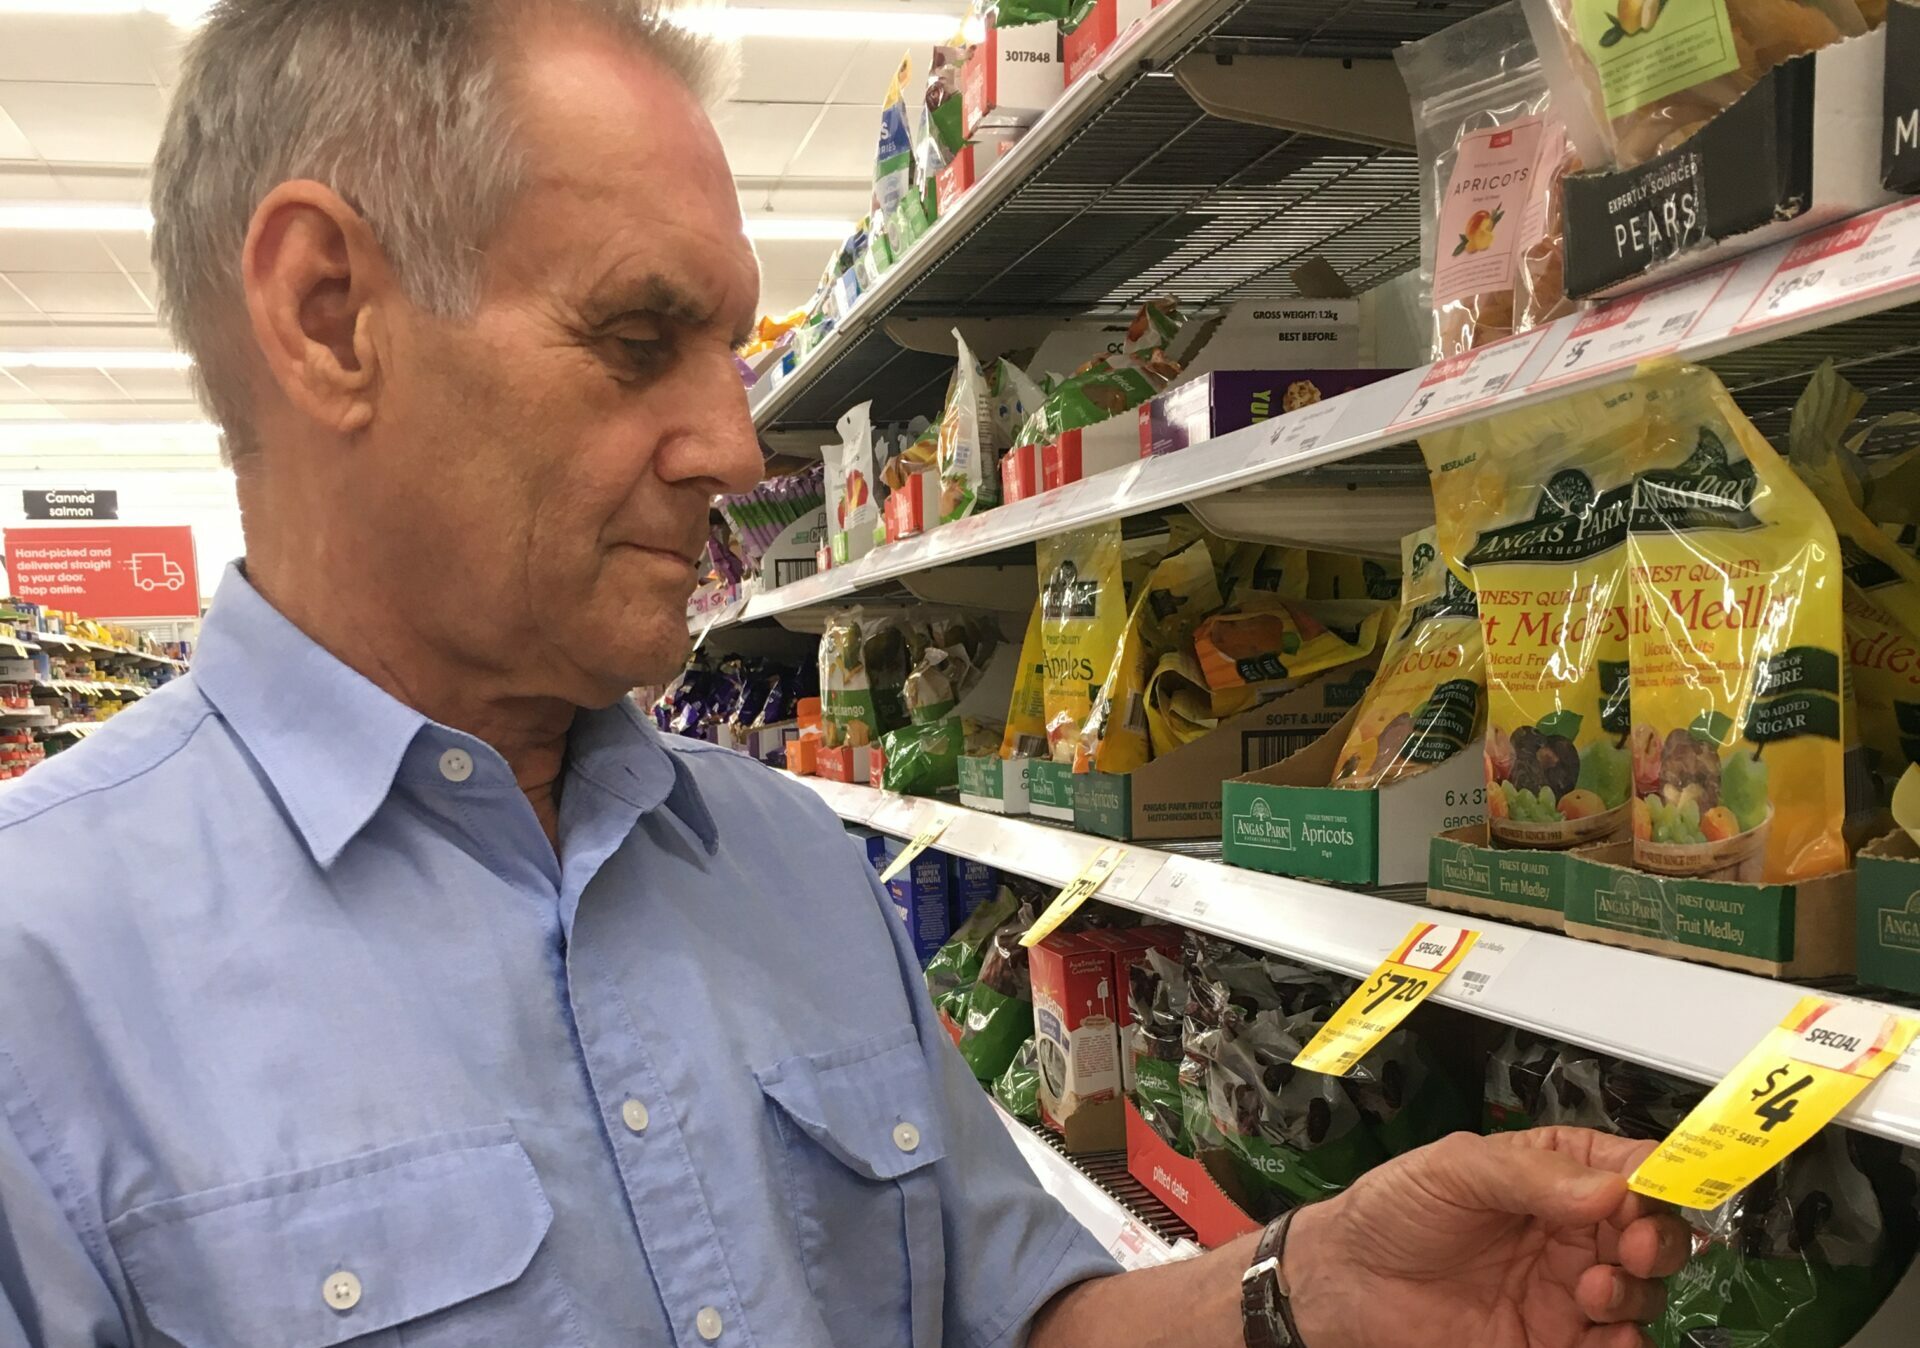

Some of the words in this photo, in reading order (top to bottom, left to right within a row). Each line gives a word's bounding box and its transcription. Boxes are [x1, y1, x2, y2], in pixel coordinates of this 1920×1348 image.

[1005, 50, 1051, 63] 3017848
[1894, 108, 1919, 156] M
[1453, 167, 1529, 196] APRICOTS
[1608, 184, 1647, 215] EXPERTLY
[1650, 162, 1698, 194] SOURCED
[1614, 192, 1697, 258] PEARS
[1253, 310, 1281, 319] GROSS
[1282, 310, 1318, 319] WEIGHT:
[1279, 332, 1301, 341] BEST
[1302, 332, 1338, 341] BEFORE:
[1111, 373, 1136, 393] dried
[45, 492, 95, 504] Canned
[1690, 474, 1751, 509] PARK
[49, 506, 93, 516] salmon
[1474, 522, 1566, 556] ANGAS
[1573, 500, 1629, 542] PARK
[15, 548, 87, 559] Hand-picked
[89, 547, 112, 557] and
[16, 561, 68, 570] delivered
[70, 560, 111, 571] straight
[1630, 565, 1687, 585] FINEST
[1689, 559, 1760, 582] QUALITY
[17, 574, 29, 582] to
[31, 575, 56, 584] your
[57, 573, 86, 581] door.
[19, 585, 47, 597] Shop
[49, 585, 87, 594] online.
[1478, 590, 1534, 605] FINEST
[1536, 584, 1604, 605] QUALIT
[1042, 650, 1094, 686] Apples
[1789, 655, 1803, 667] OF
[1770, 700, 1810, 716] ADDED
[1266, 713, 1298, 726] SOFT
[1300, 713, 1309, 725] &
[1755, 713, 1807, 734] SUGAR
[1410, 748, 1446, 760] SUGAR
[1424, 742, 1451, 750] ADDED
[1143, 803, 1167, 812] ANGAS
[1168, 802, 1187, 811] PARK
[1188, 801, 1209, 810] FRUIT
[1445, 790, 1455, 807] 6
[1459, 793, 1469, 806] x
[1237, 819, 1265, 837] ANGAS
[1266, 821, 1289, 839] PARK
[1301, 822, 1354, 846] Apricots
[1445, 864, 1467, 880] ANGAS
[1468, 866, 1487, 883] PARK
[1499, 859, 1521, 871] FINEST
[1521, 862, 1550, 875] QUALITY
[1500, 877, 1519, 893] Fruit
[1520, 879, 1550, 901] Medley
[1599, 895, 1630, 916] ANGAS
[1632, 902, 1660, 920] PARK
[1675, 893, 1703, 908] FINEST
[1704, 898, 1745, 915] QUALITY
[1676, 914, 1701, 934] Fruit
[1703, 919, 1745, 946] Medley
[1415, 941, 1447, 957] SPECIAL
[1069, 959, 1105, 968] Australian
[1805, 1028, 1861, 1053] SPECIAL
[1709, 1122, 1728, 1136] WAS
[1736, 1132, 1762, 1147] SAVE
[1153, 1165, 1171, 1191] pitted
[1171, 1177, 1189, 1204] dates
